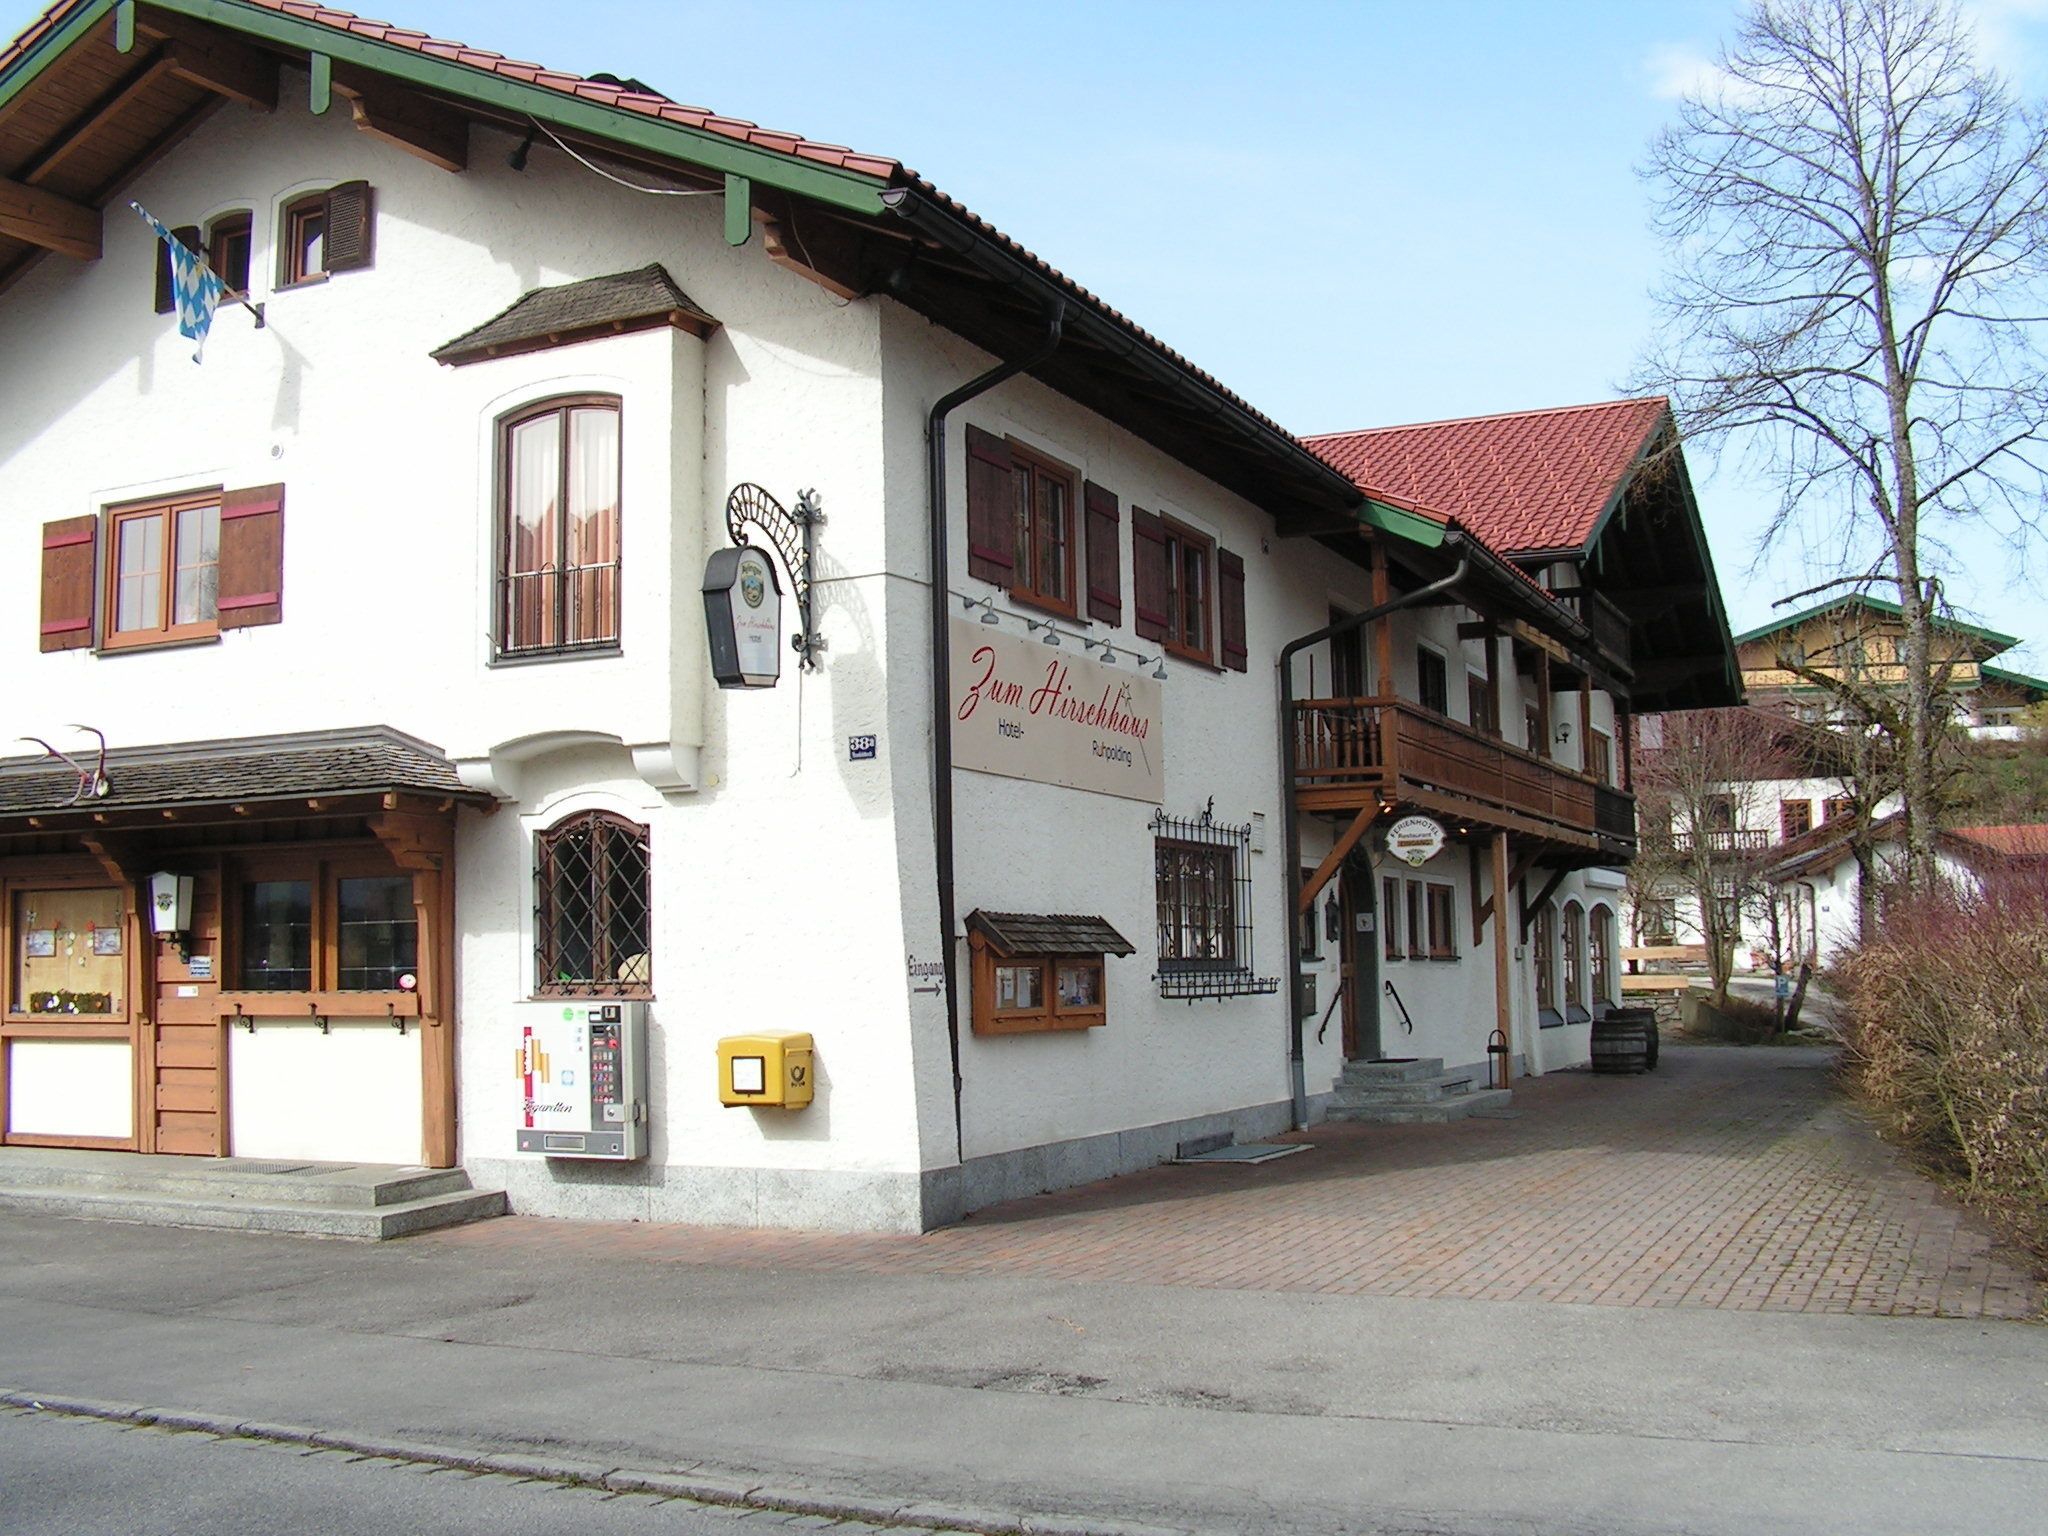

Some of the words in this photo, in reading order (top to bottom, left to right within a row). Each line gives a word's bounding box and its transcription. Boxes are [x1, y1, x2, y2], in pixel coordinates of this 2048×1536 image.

[958, 646, 1023, 721] Zum
[1029, 660, 1149, 739] Hirschhaus
[1390, 819, 1439, 838] FERIENHOTEL
[908, 954, 944, 983] Eingang
[1778, 976, 1788, 988] P
